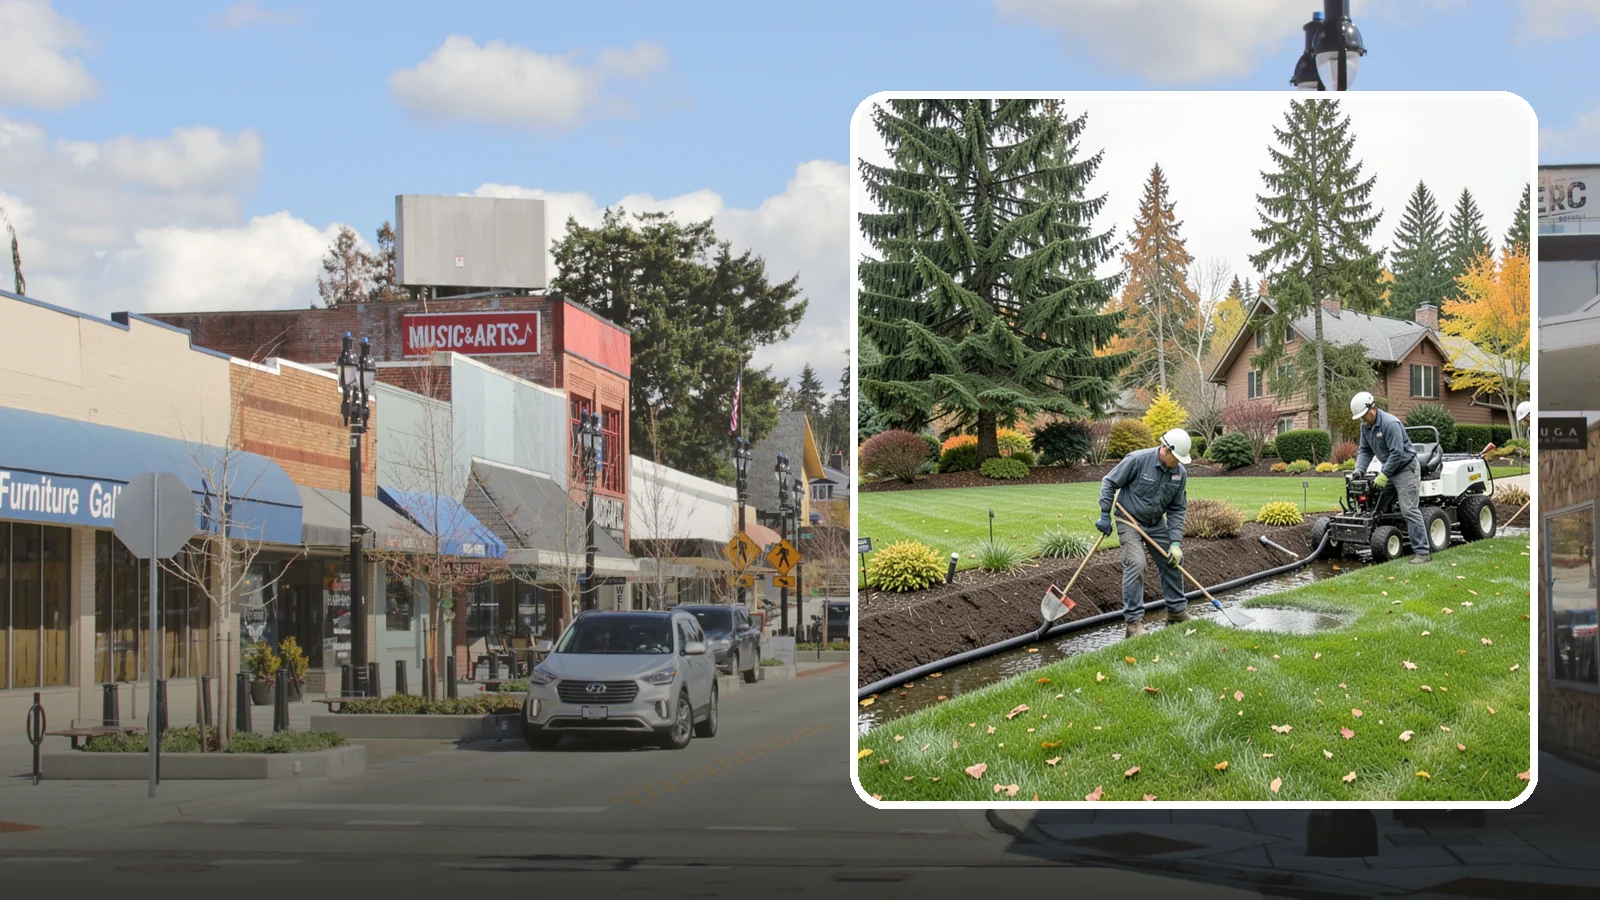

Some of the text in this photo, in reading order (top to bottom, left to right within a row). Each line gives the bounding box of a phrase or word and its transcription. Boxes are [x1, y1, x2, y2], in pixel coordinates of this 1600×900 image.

[409, 322, 519, 349] MUSIC&ARTS
[1540, 427, 1577, 436] UGA
[0, 471, 122, 518] Furniture Gal
[453, 563, 479, 574] SUSHI
